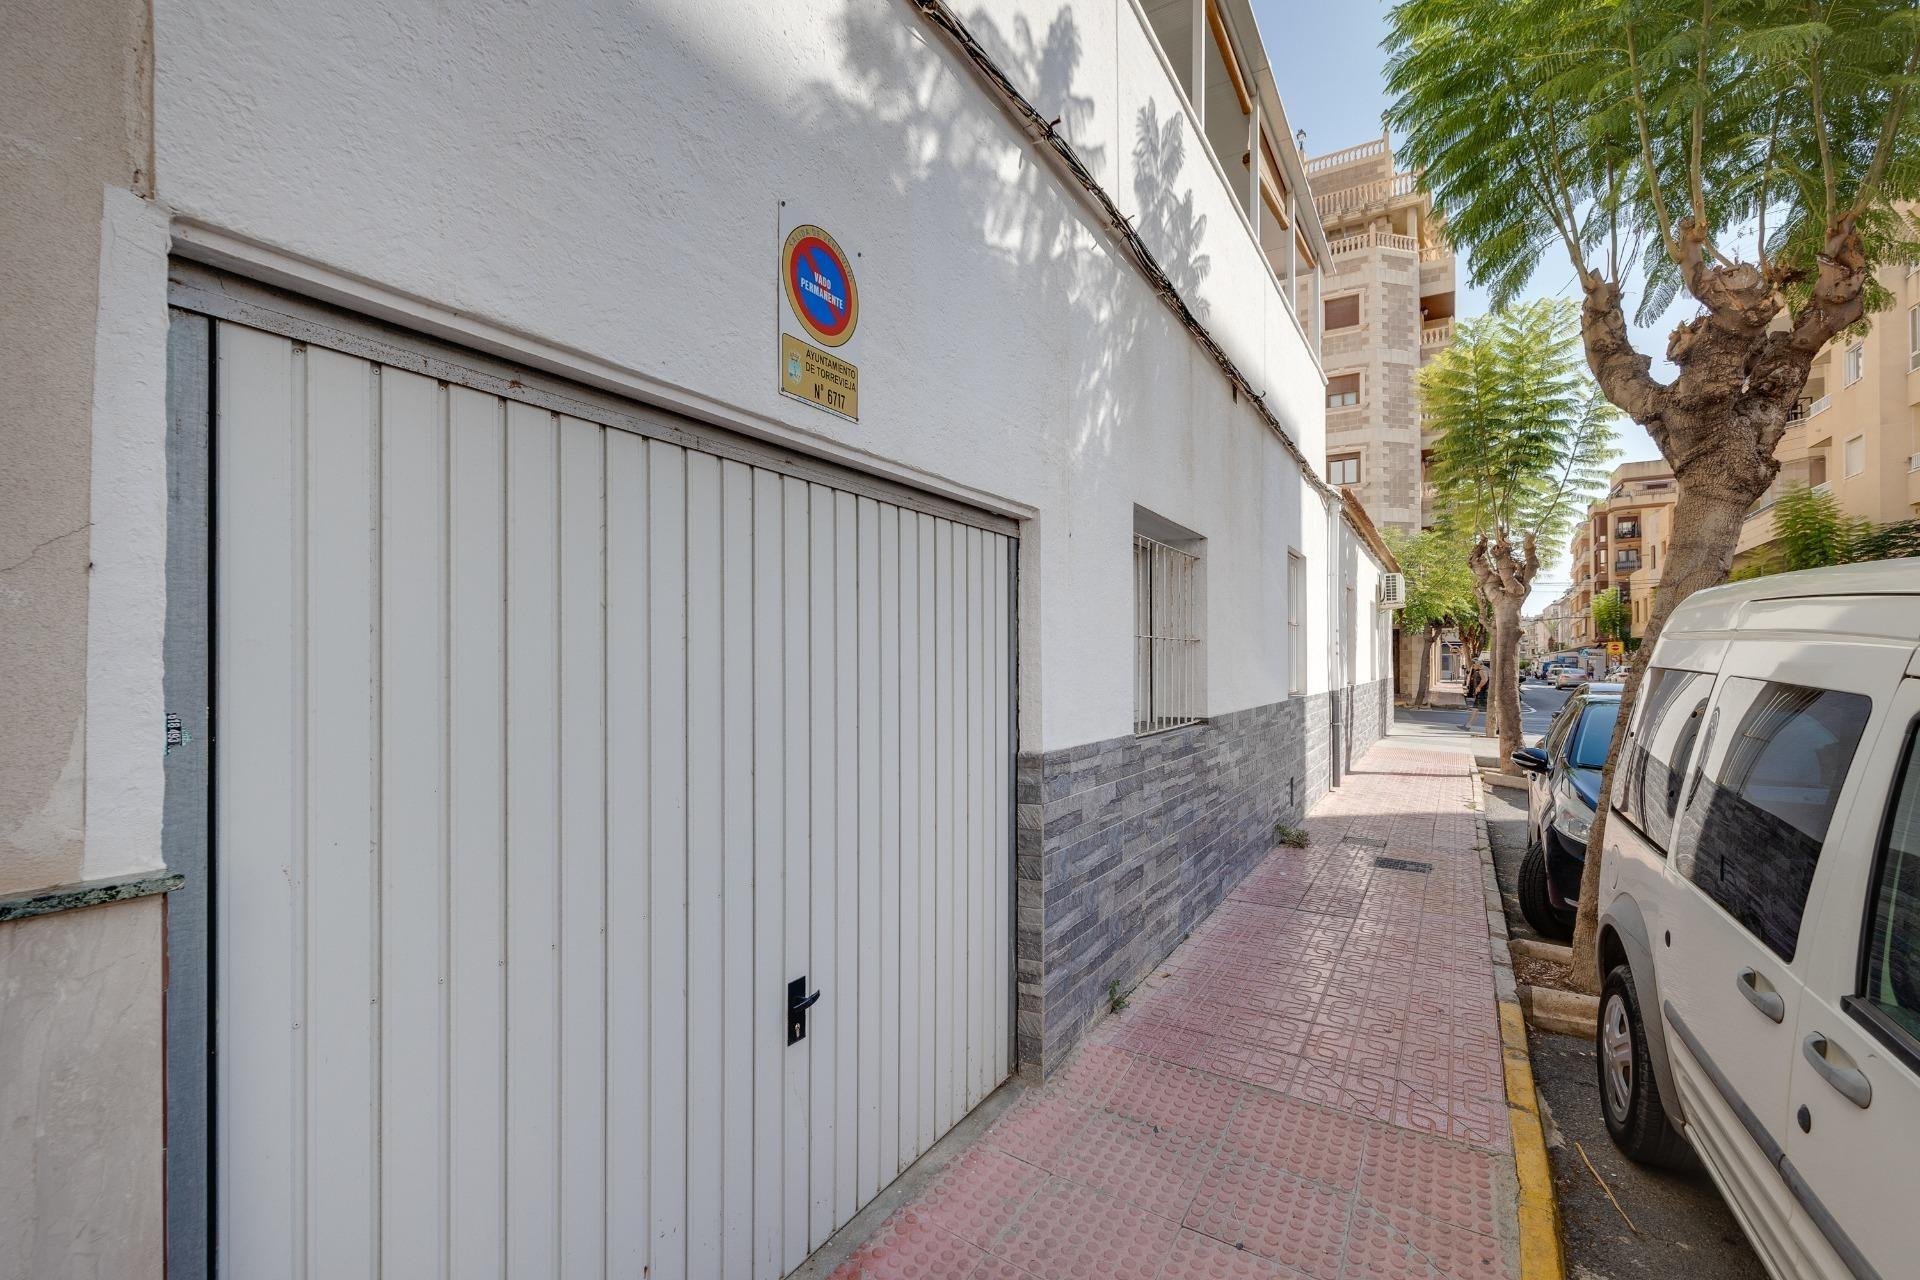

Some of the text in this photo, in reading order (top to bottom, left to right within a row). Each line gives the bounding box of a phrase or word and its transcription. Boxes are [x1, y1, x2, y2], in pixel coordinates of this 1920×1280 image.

[800, 278, 844, 310] PERMANENTE
[814, 271, 832, 289] VADO
[805, 349, 856, 380] AYUNTAMIENTO
[805, 362, 857, 392] DE TORREVIEJA
[827, 388, 846, 410] 6717
